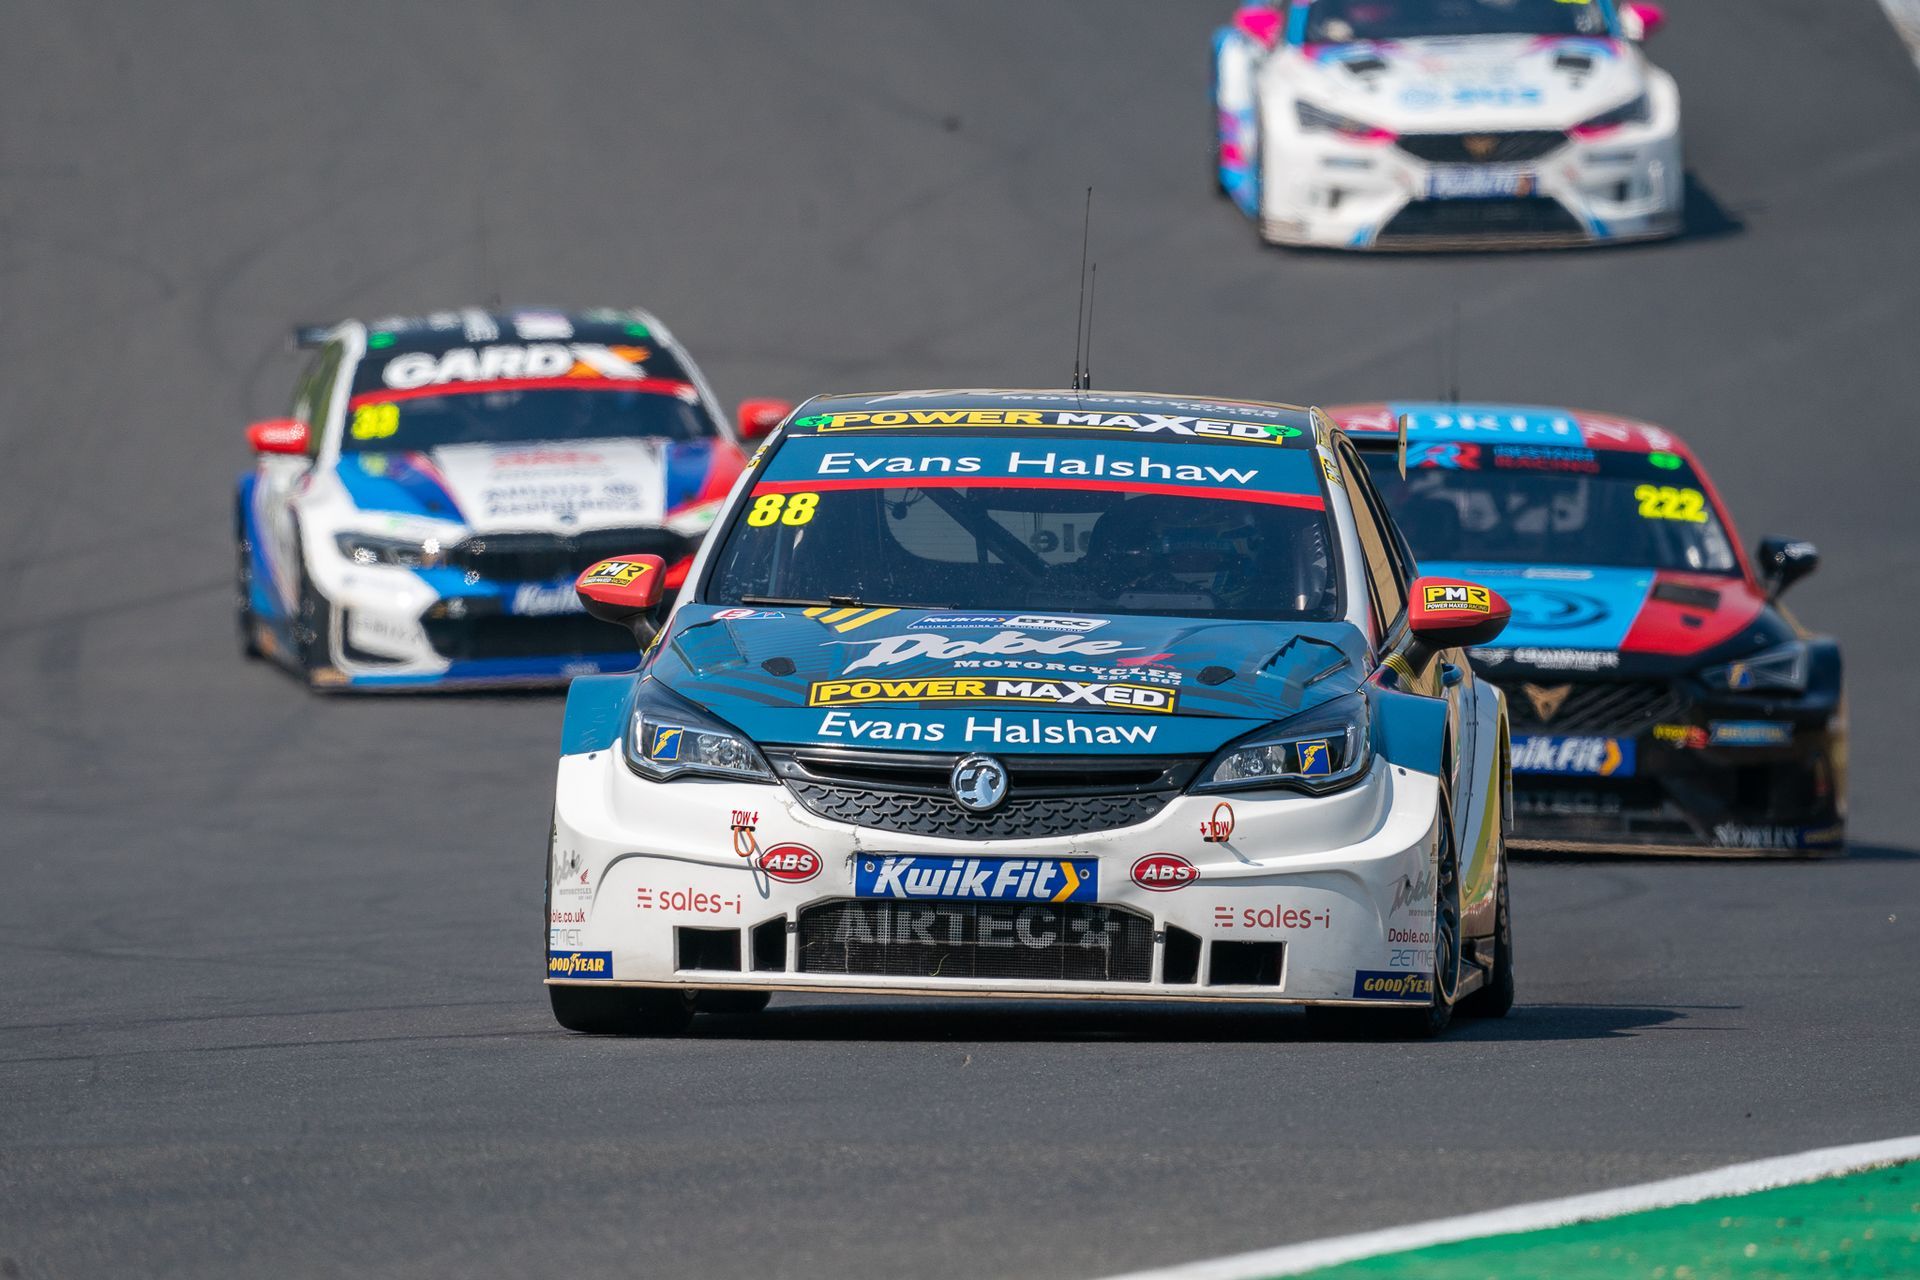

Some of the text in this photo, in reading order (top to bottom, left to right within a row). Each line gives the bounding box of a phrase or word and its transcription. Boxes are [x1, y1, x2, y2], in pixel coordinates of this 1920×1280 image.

[829, 412, 1043, 428] POWER
[1056, 412, 1271, 438] MAXED
[817, 452, 1259, 484] Evans Halshaw
[747, 492, 820, 527] 88
[1635, 484, 1708, 523] 222
[588, 562, 645, 577] PMR
[1427, 587, 1487, 602] PMR
[819, 631, 1146, 675] Doble
[954, 659, 1182, 680] MOTORCYCLES
[819, 680, 1165, 706] POWER MAXED
[817, 711, 1158, 744] Evans Halshaw
[731, 810, 751, 825] TOW
[1208, 820, 1230, 836] TOW
[765, 854, 814, 872] ABS
[1141, 863, 1191, 881] ABS
[659, 887, 741, 915] sales-i
[833, 901, 1058, 949] AIRTEC
[1243, 904, 1331, 929] sales-i
